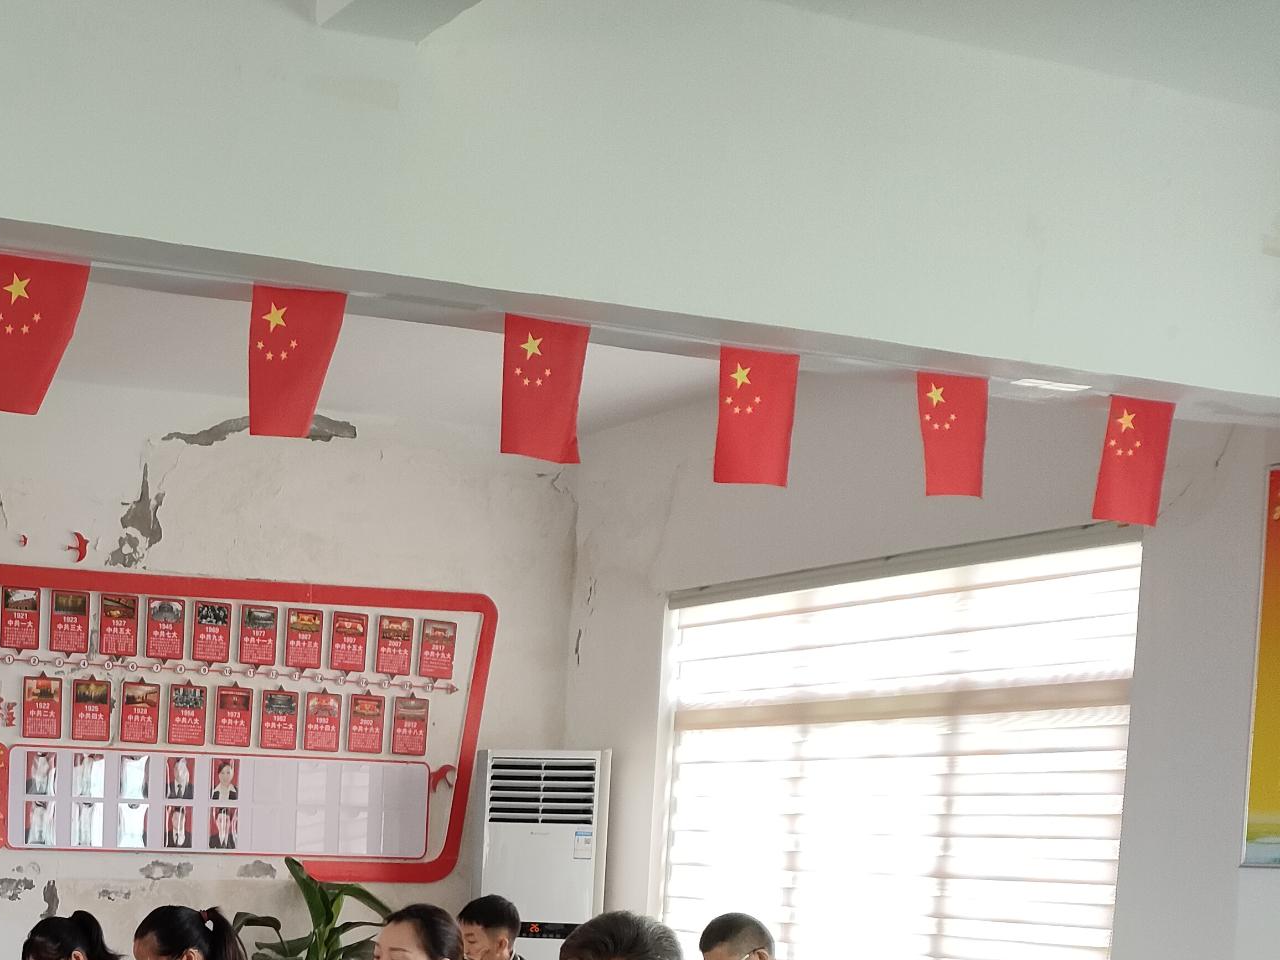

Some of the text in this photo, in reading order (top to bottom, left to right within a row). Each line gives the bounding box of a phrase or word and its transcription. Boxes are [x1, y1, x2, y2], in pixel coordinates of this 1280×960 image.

[7, 619, 34, 628] 中共一大
[57, 624, 82, 632] 中共三大
[152, 630, 178, 638] 中共七大
[29, 709, 56, 717] 中共二大
